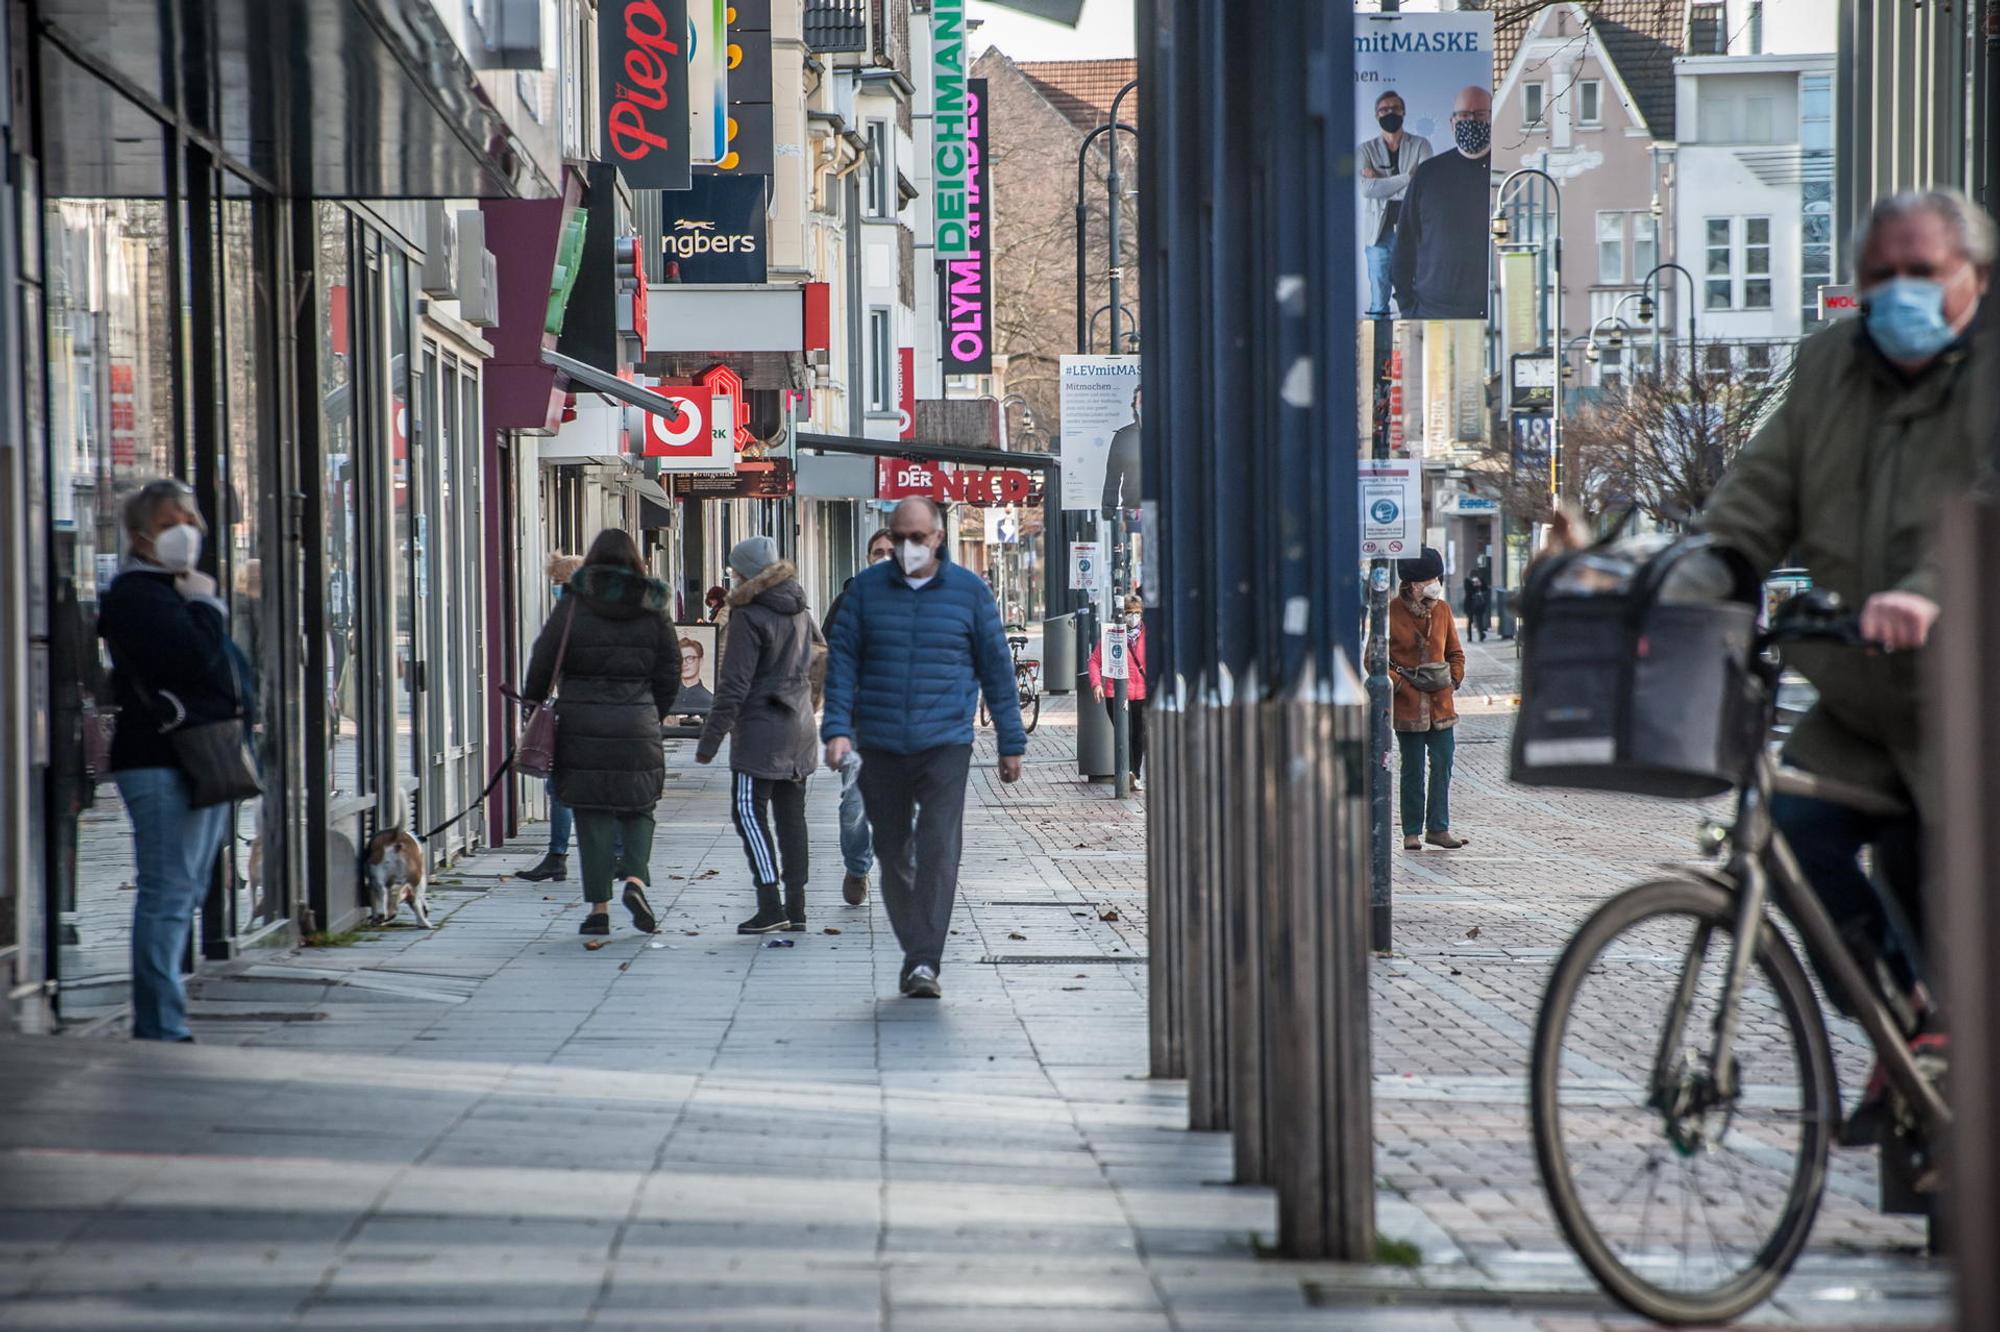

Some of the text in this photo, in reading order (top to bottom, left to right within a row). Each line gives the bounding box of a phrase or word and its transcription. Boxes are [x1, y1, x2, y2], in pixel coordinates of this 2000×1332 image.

[934, 0, 965, 251] DEICHMAN
[898, 470, 932, 487] DER
[933, 470, 1030, 502] NKD
